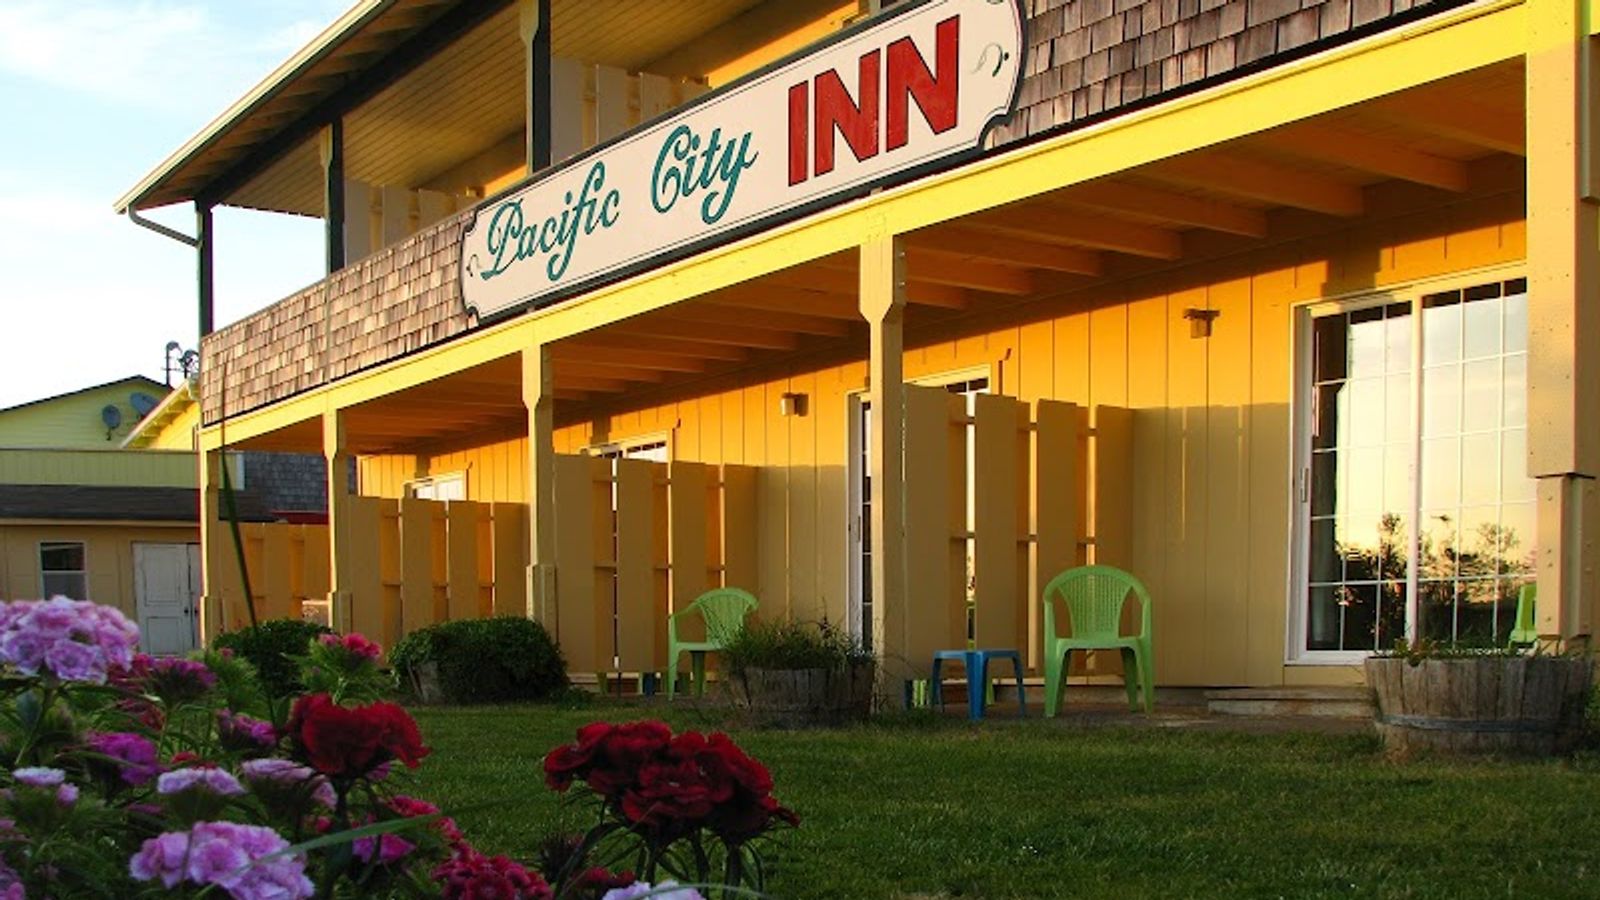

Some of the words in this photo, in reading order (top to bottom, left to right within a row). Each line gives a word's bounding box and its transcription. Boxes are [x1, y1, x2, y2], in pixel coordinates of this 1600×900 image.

[480, 161, 620, 281] Pacific
[651, 124, 758, 224] City
[788, 14, 960, 187] INN
